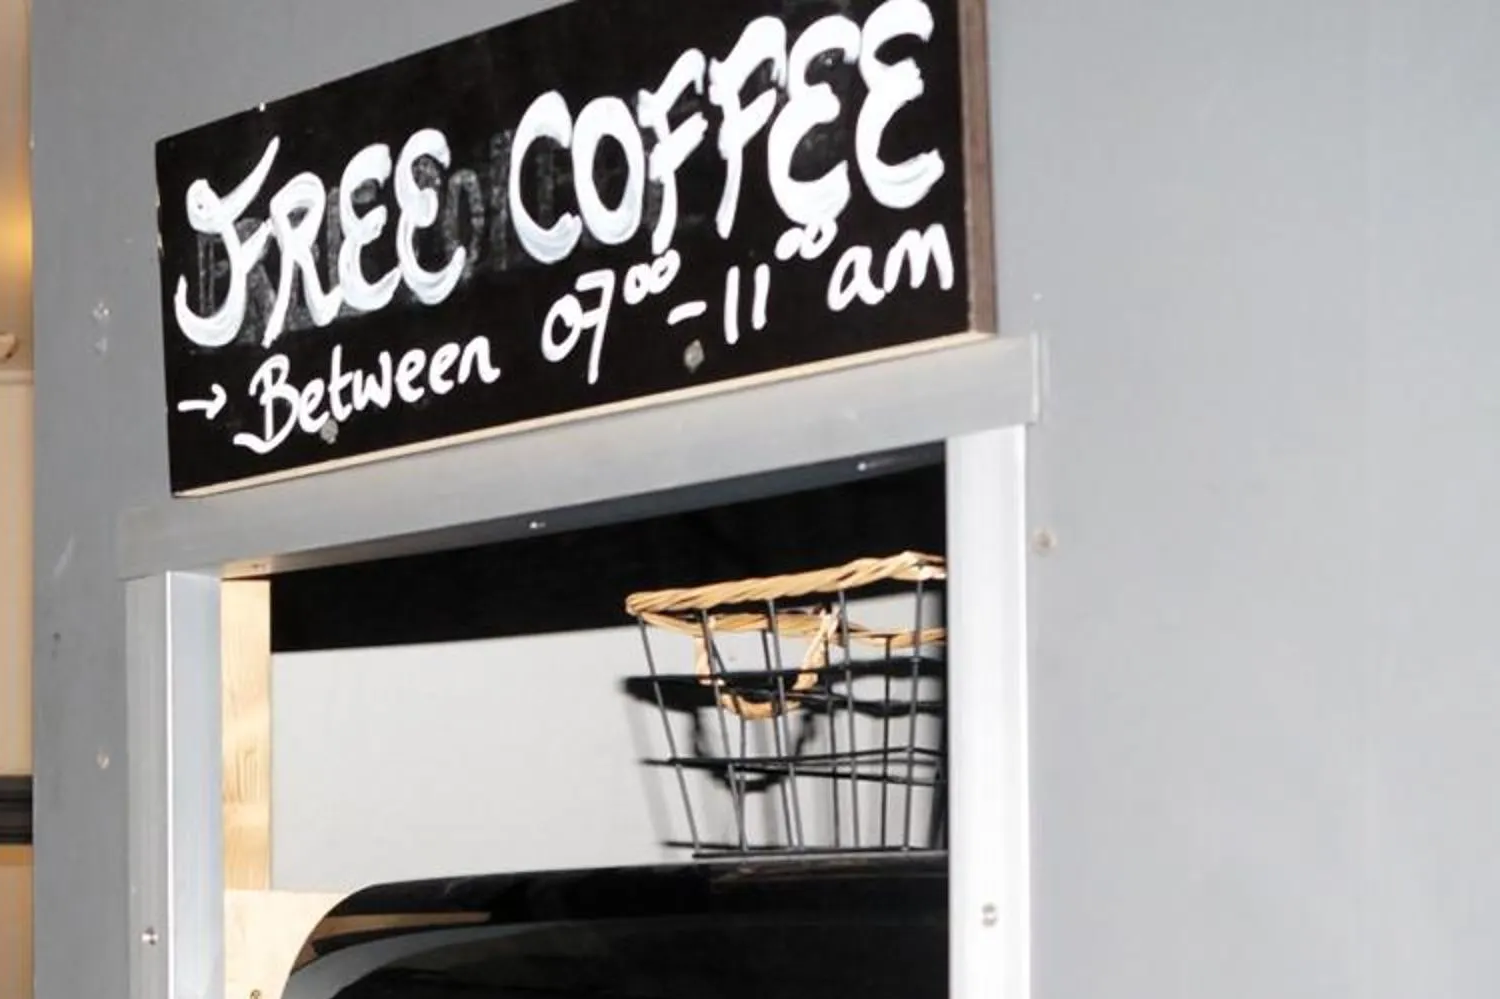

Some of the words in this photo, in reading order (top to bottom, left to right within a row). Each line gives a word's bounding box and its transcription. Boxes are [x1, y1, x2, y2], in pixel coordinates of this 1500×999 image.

[174, 135, 467, 348] FREE
[508, 0, 945, 264] COFFEE
[233, 335, 501, 454] Between
[827, 223, 955, 312] am
